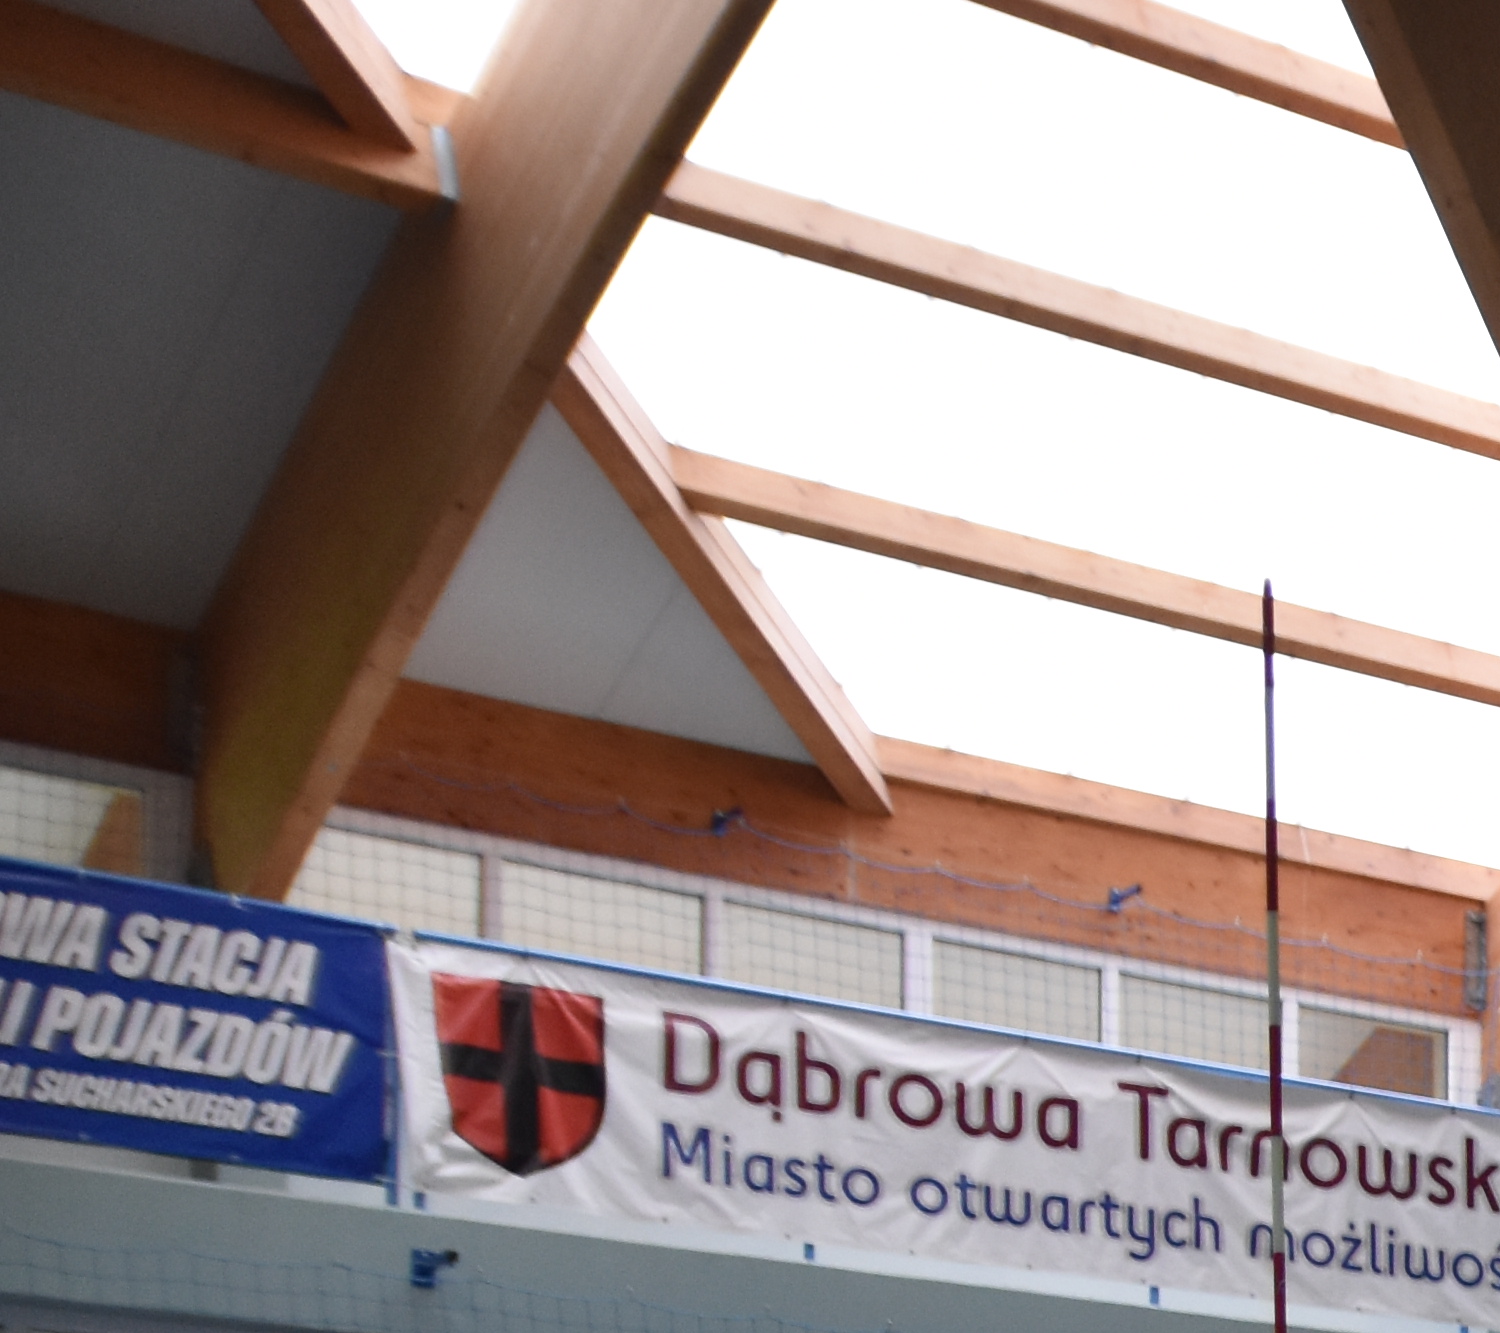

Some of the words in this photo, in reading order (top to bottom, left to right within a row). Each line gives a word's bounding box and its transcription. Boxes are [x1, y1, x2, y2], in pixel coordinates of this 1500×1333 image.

[109, 912, 319, 1006] STACJA
[31, 985, 355, 1094] POJAZDÓW
[661, 1010, 1081, 1150] Dąbrowa
[32, 1068, 254, 1132] SUCHARSKIEGO
[660, 1121, 881, 1207] Miasto
[908, 1170, 1221, 1262] otwartych
